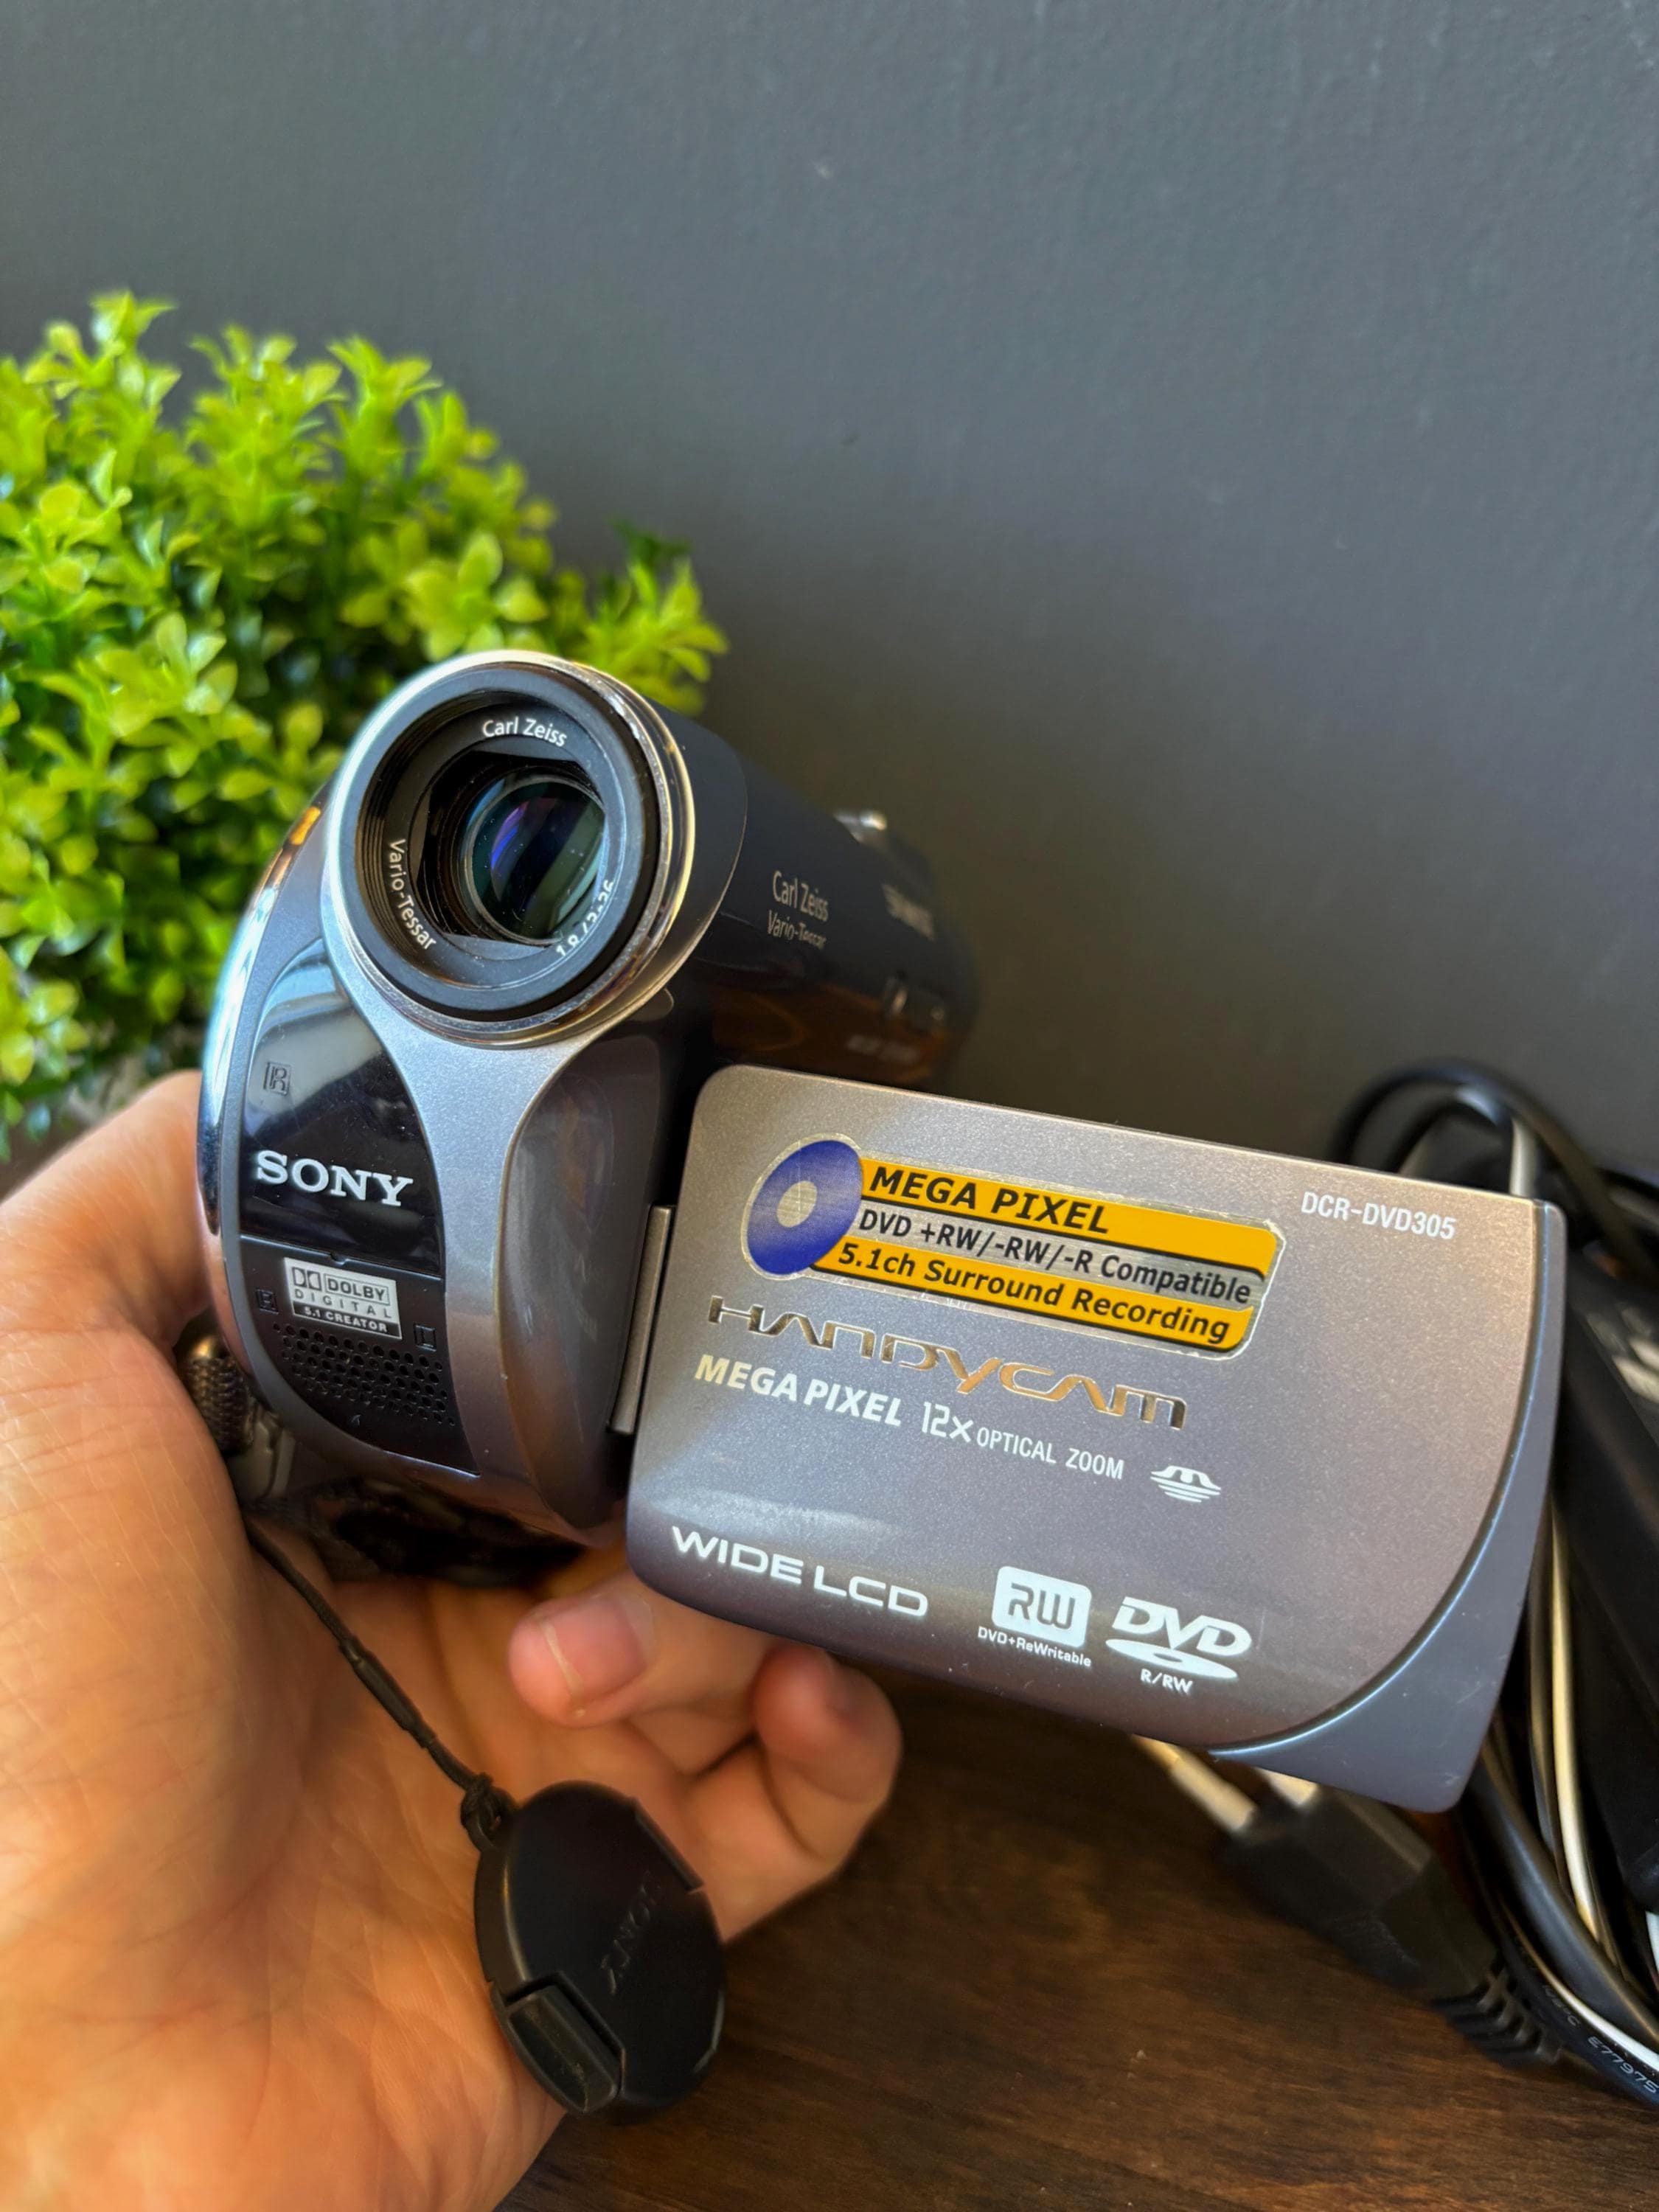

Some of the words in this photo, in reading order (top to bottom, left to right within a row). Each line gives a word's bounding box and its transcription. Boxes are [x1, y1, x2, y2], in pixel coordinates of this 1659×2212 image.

[482, 716, 518, 738] Carl
[524, 718, 568, 748] Zeiss
[388, 838, 437, 951] Vario-Tessar
[773, 871, 798, 908] Carl
[801, 883, 828, 922] Zeiss
[256, 1150, 413, 1207] SONY
[870, 1166, 977, 1210] MEGA
[991, 1188, 1109, 1234] PIXEL
[1301, 1192, 1456, 1239] DCR-DVD305
[859, 1209, 911, 1237] DVD
[921, 1224, 1093, 1273] +RW/-RW/-R
[1100, 1254, 1251, 1304] Compatible
[295, 1289, 392, 1318] DIGITAL
[328, 1279, 385, 1301] DOLBY
[838, 1244, 916, 1278] 5.1ch
[925, 1263, 1066, 1306] Surround
[1071, 1289, 1231, 1344] Recording
[305, 1307, 321, 1318] 5.1
[326, 1312, 387, 1332] CREATOR
[695, 1354, 797, 1401] MEGA
[804, 1379, 902, 1427] PIXEL
[976, 1427, 1057, 1464] OPTICAL
[1065, 1448, 1125, 1480] ZOOM
[672, 1526, 804, 1585] WIDE
[814, 1565, 928, 1617] LCD
[1008, 1582, 1075, 1630] RW
[1112, 1596, 1252, 1657] DVD
[978, 1626, 1092, 1667] DVD+ReWritable
[1141, 1669, 1193, 1694] R/RW
